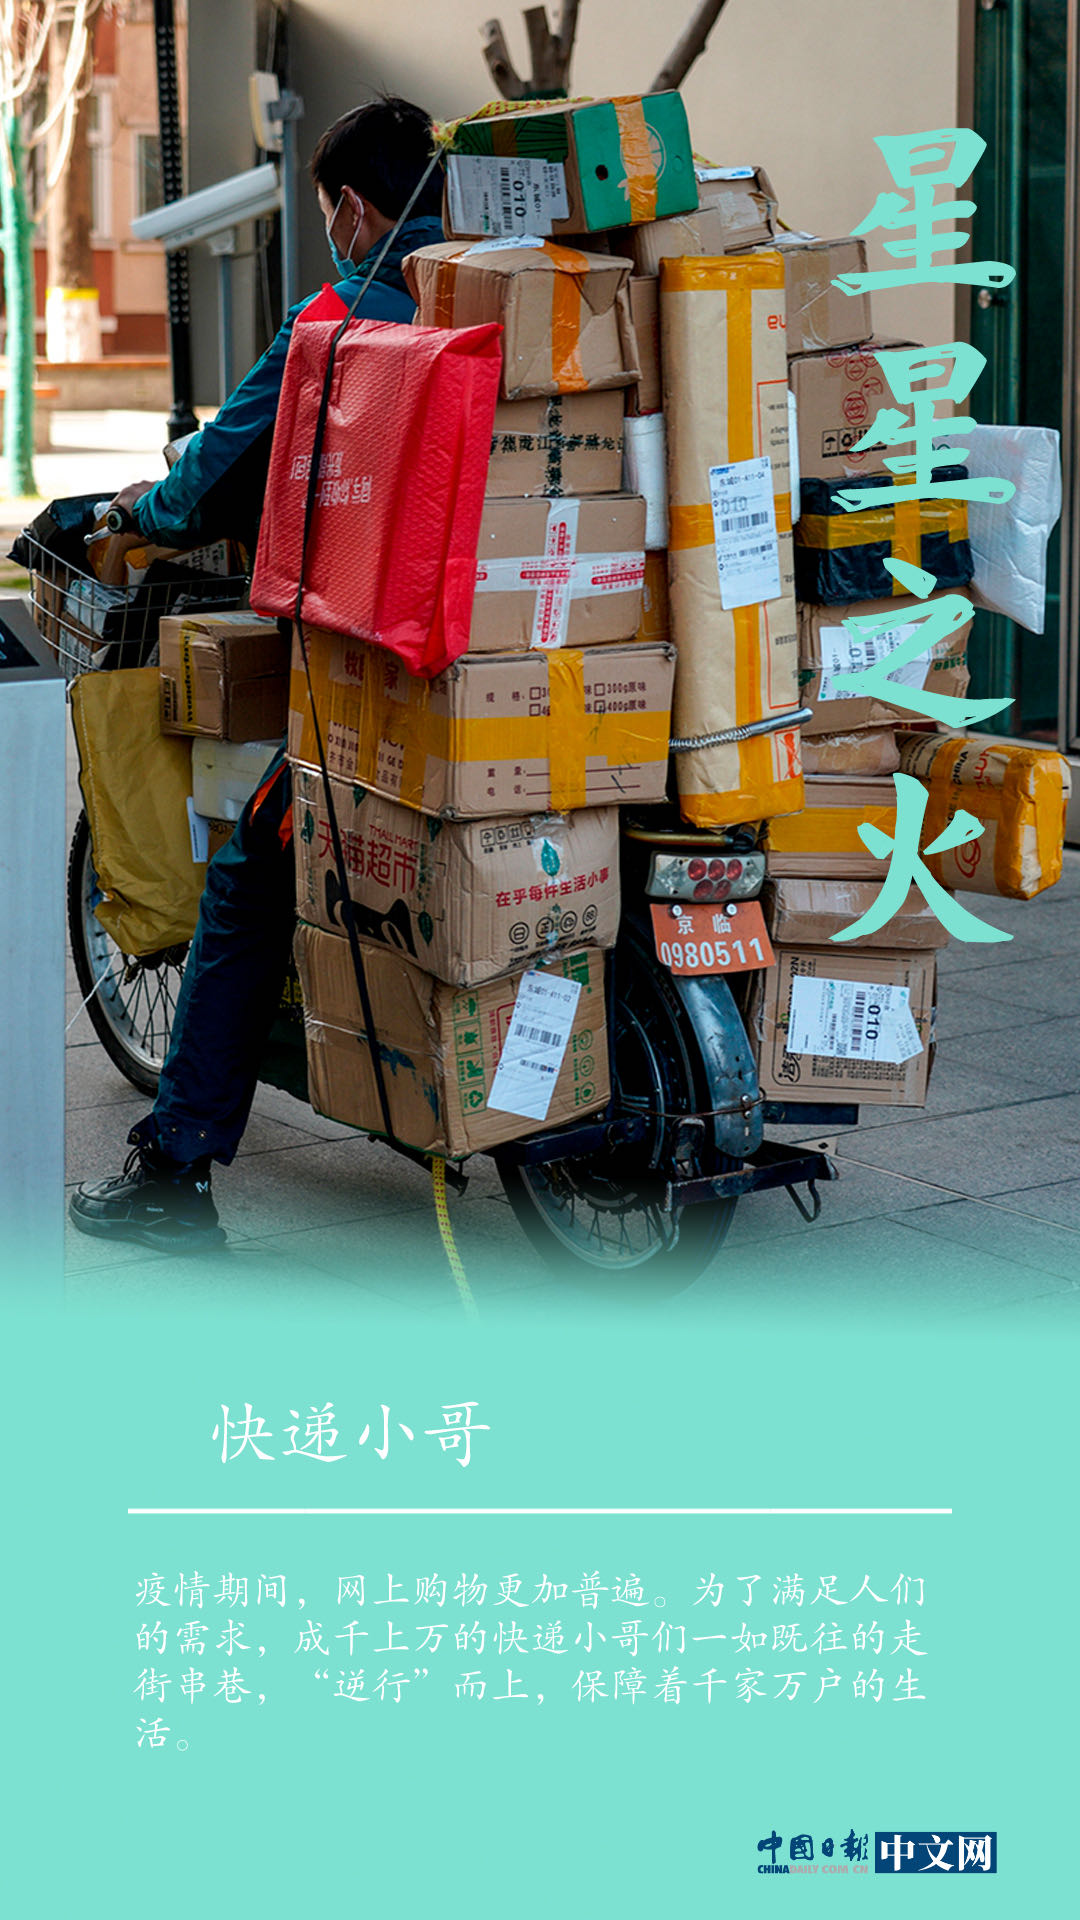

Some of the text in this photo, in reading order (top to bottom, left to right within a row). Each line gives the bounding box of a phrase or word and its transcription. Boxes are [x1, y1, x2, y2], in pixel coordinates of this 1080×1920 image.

[513, 181, 527, 217] 010
[317, 820, 418, 894] 天猫超市
[495, 866, 610, 908] 在乎每件生活小事
[676, 913, 732, 936] 京 临
[660, 937, 765, 969] 0980511
[865, 1003, 882, 1041] 010
